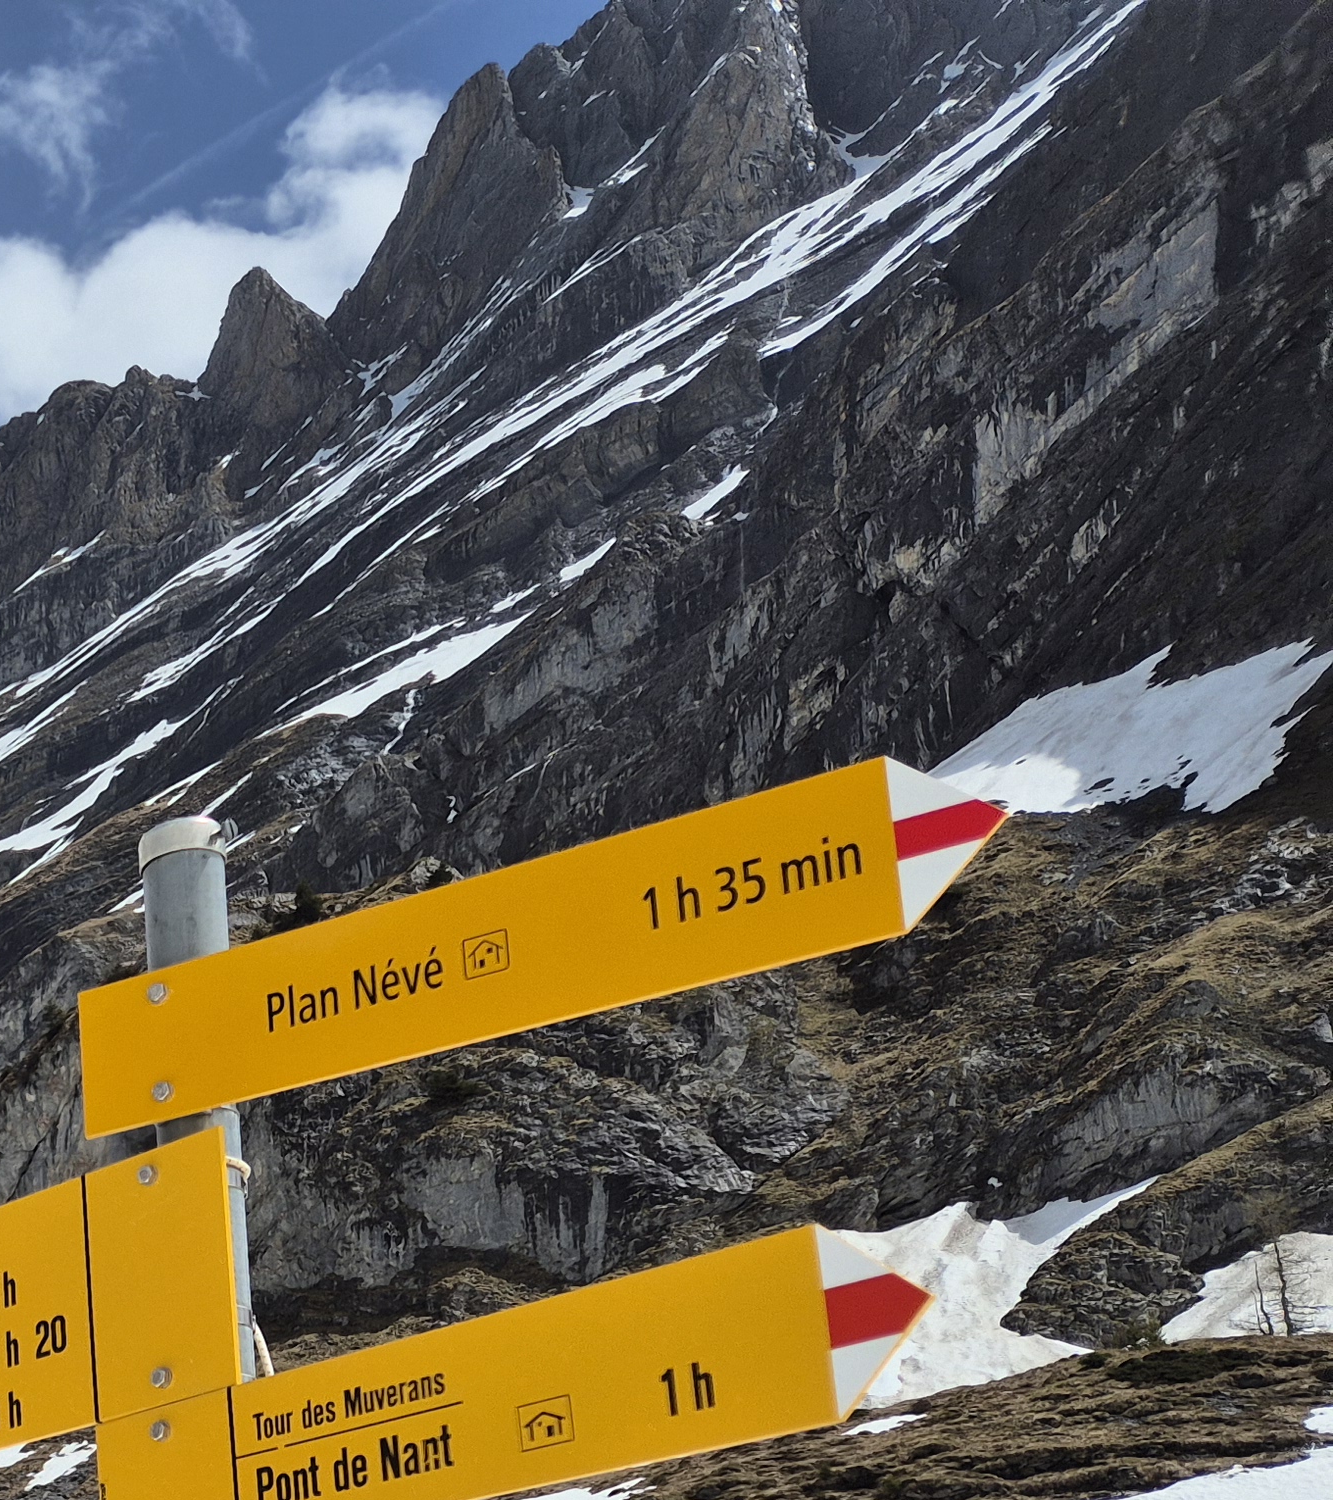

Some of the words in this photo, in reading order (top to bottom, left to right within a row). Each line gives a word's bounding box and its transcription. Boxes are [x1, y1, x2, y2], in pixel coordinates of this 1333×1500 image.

[643, 887, 659, 930] 1
[676, 876, 701, 923] h
[715, 857, 766, 913] 35
[781, 836, 862, 894] min
[267, 984, 340, 1033] Plan
[353, 945, 444, 1010] Névé
[3, 1271, 17, 1308] h
[6, 1331, 20, 1368] h
[35, 1315, 67, 1359] 20
[8, 1391, 22, 1429] h
[252, 1411, 293, 1441] Tour
[301, 1400, 336, 1429] des
[343, 1372, 445, 1418] Muverans
[661, 1368, 679, 1417] 1
[691, 1361, 716, 1411] h
[334, 1447, 368, 1492] de
[380, 1424, 454, 1482] Nant
